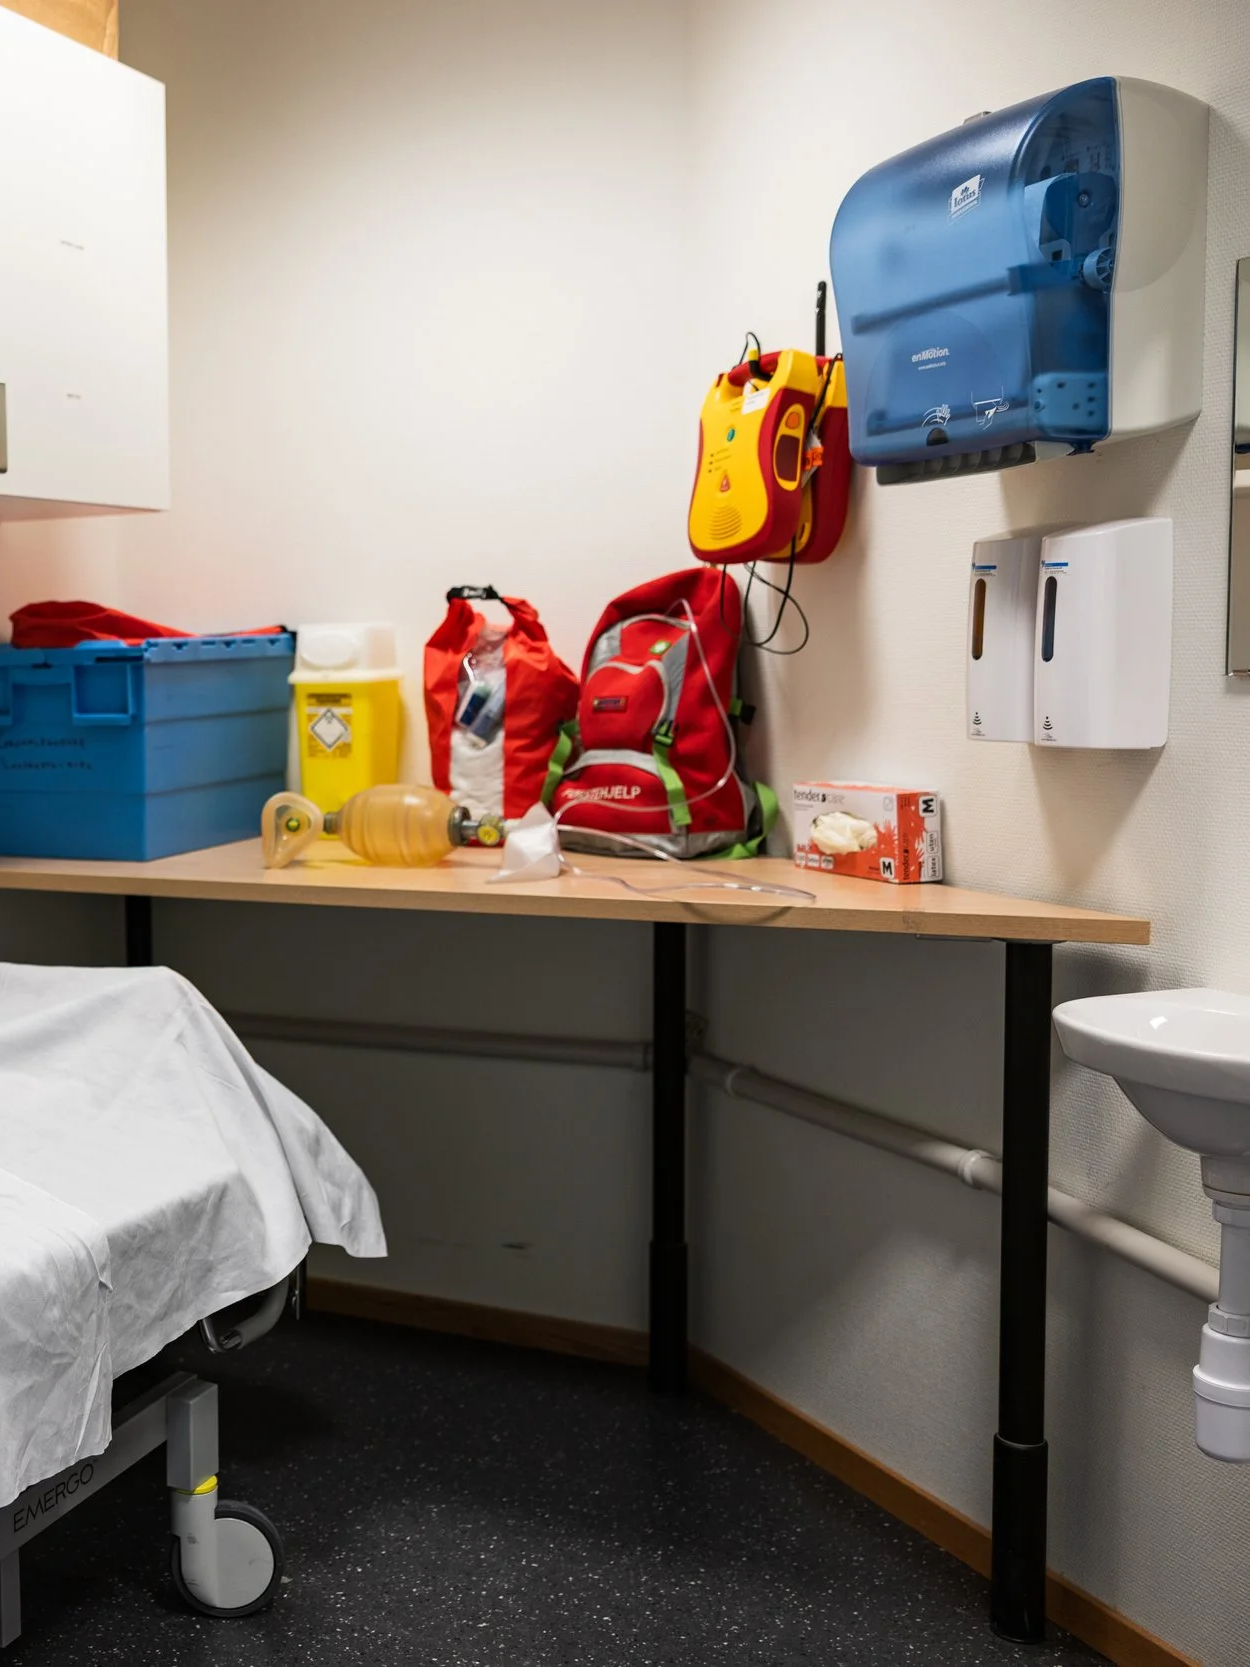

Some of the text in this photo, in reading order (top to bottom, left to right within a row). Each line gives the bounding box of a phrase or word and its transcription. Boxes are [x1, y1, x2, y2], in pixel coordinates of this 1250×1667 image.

[953, 190, 976, 207] lotus
[922, 798, 934, 814] M
[882, 861, 893, 876] M
[13, 1463, 94, 1533] EMERGO
